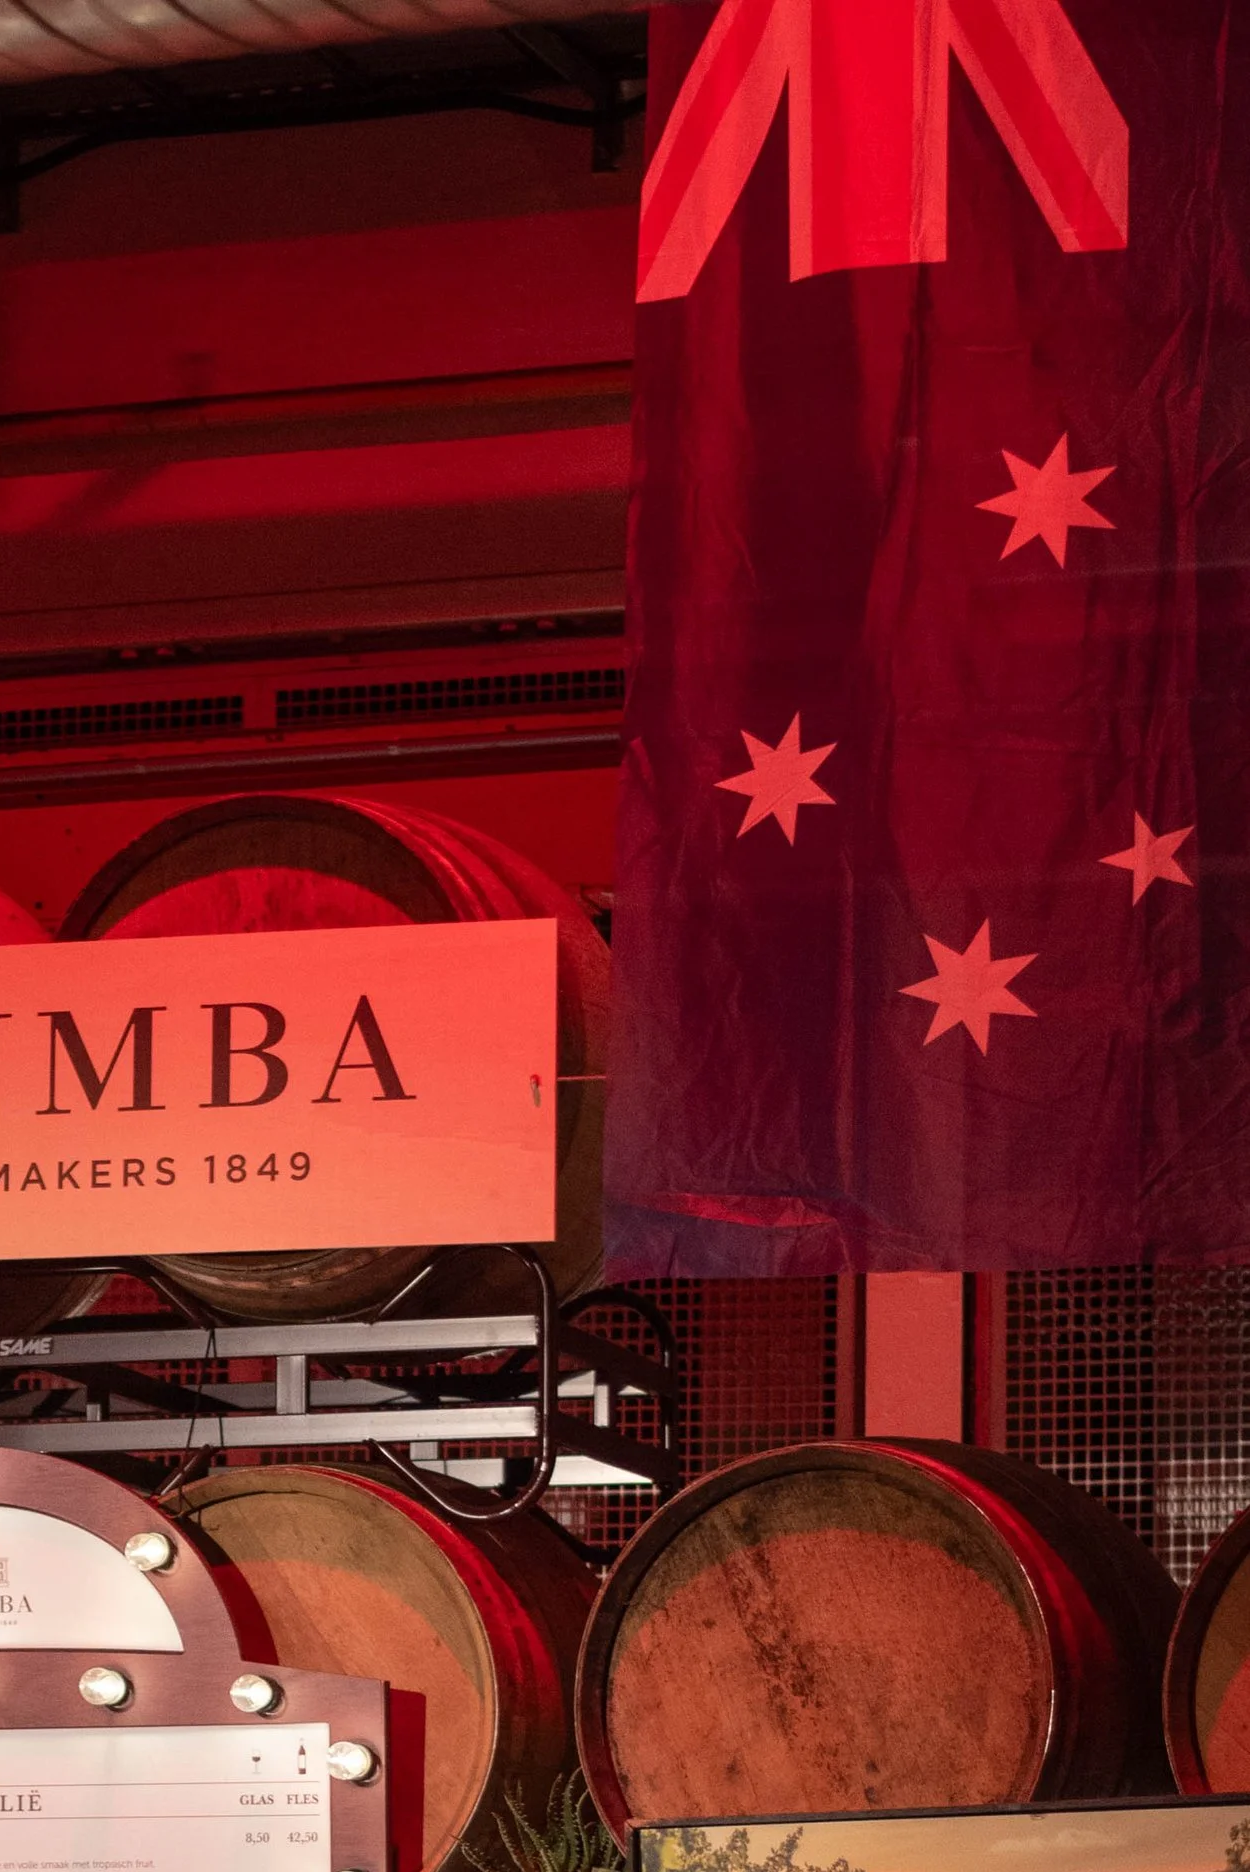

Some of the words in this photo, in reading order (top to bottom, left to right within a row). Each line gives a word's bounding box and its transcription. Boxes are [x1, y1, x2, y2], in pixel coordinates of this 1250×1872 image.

[204, 1152, 310, 1183] 1849
[0, 1337, 53, 1357] SAME
[240, 1795, 274, 1805] GLAS
[287, 1794, 319, 1804] FLES
[246, 1832, 270, 1844] 8,50
[287, 1832, 318, 1844] 42,50
